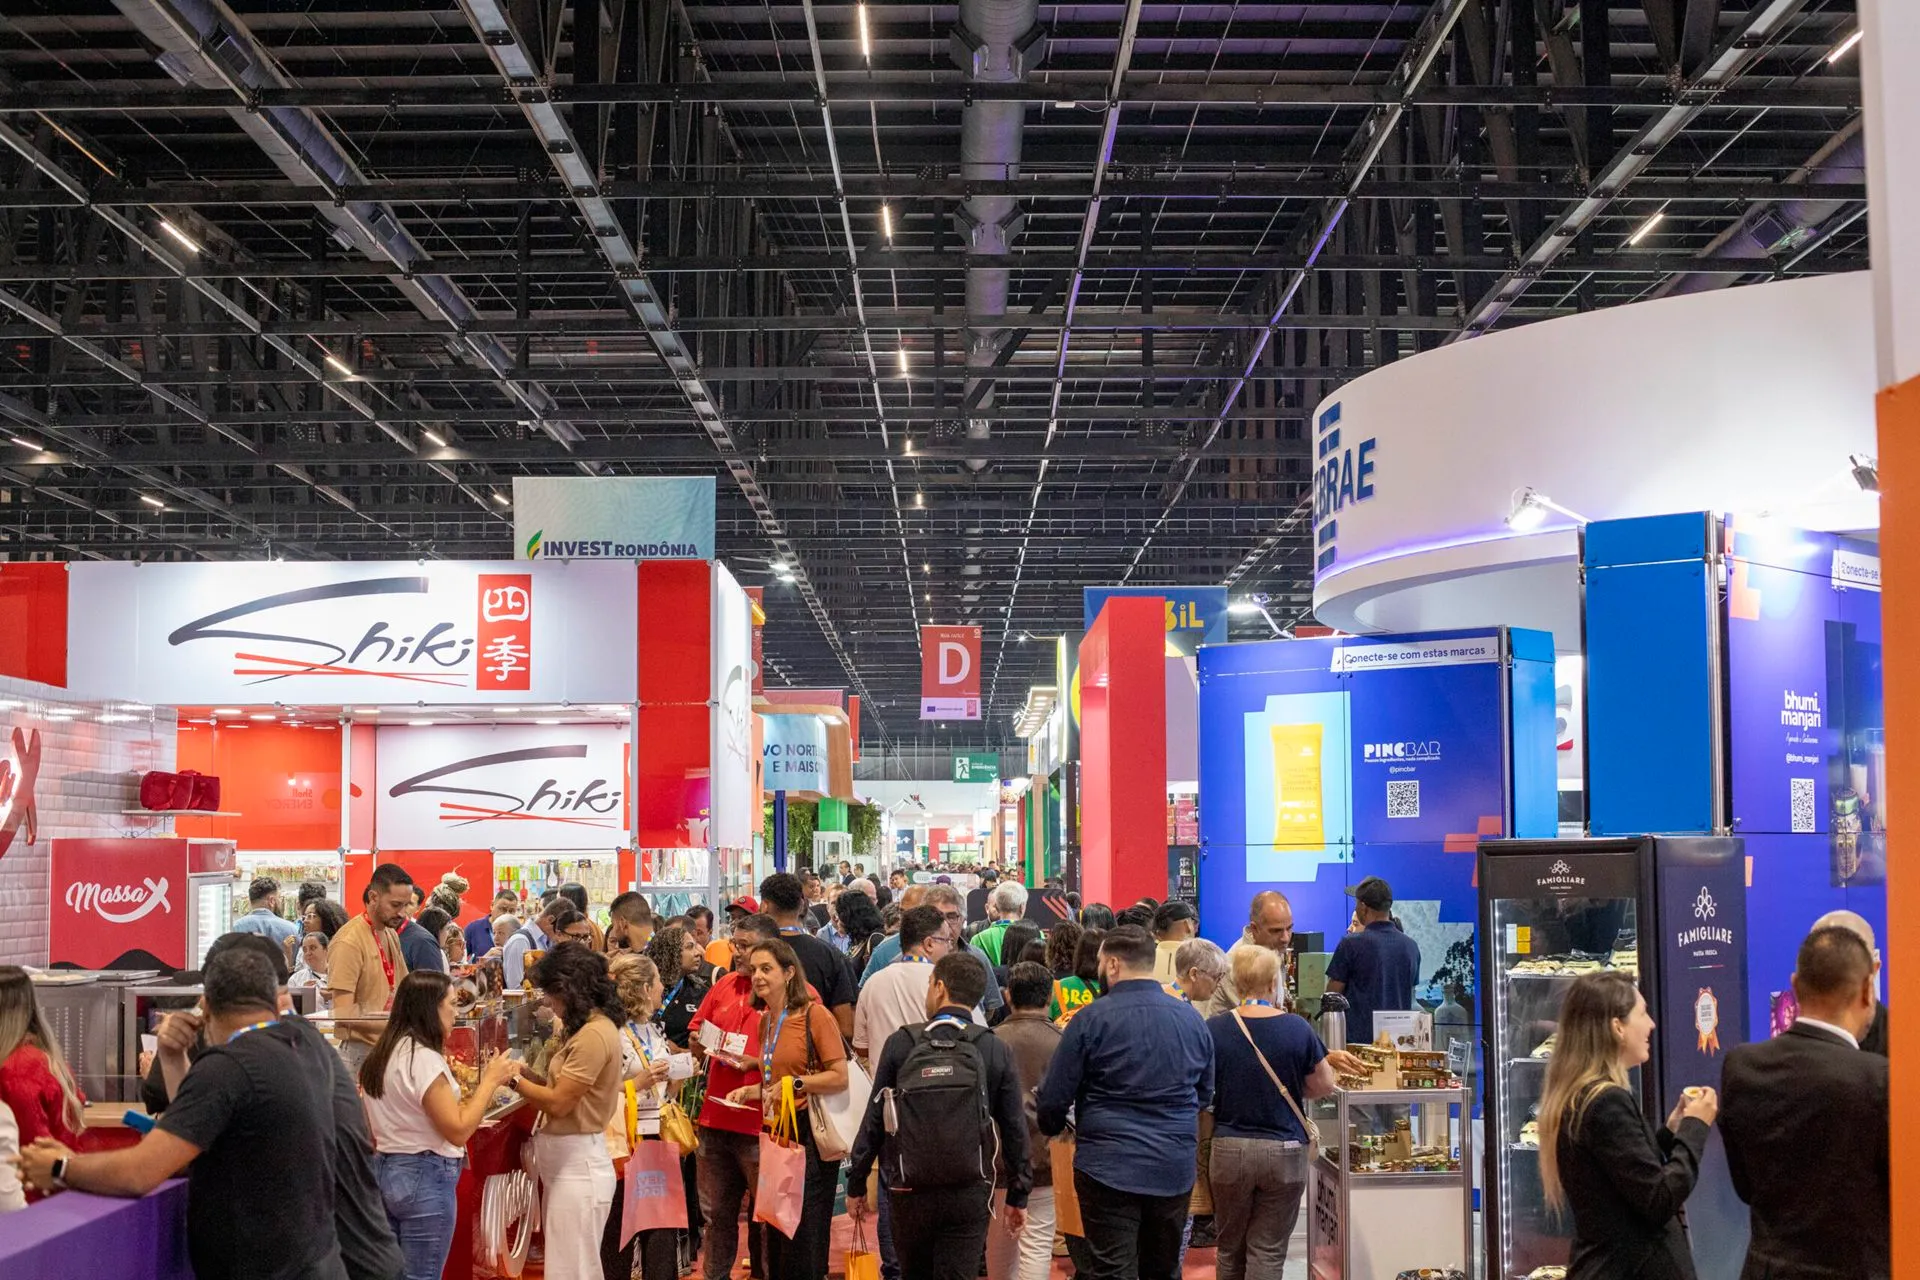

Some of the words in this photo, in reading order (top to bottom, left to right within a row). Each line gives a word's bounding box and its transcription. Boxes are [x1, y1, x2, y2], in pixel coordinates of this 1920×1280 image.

[544, 541, 613, 556] INVEST
[615, 541, 698, 556] RONDÔNIA
[168, 577, 475, 686] Shiki
[939, 642, 971, 685] D
[1344, 653, 1398, 663] Conecte-se
[1400, 651, 1421, 660] com
[1423, 649, 1448, 659] estas
[1450, 646, 1486, 657] marcas
[773, 760, 780, 772] E
[389, 744, 622, 828] Shiki
[1536, 876, 1585, 886] FAMIGLIARE
[1678, 926, 1733, 948] FAMIGLIARE
